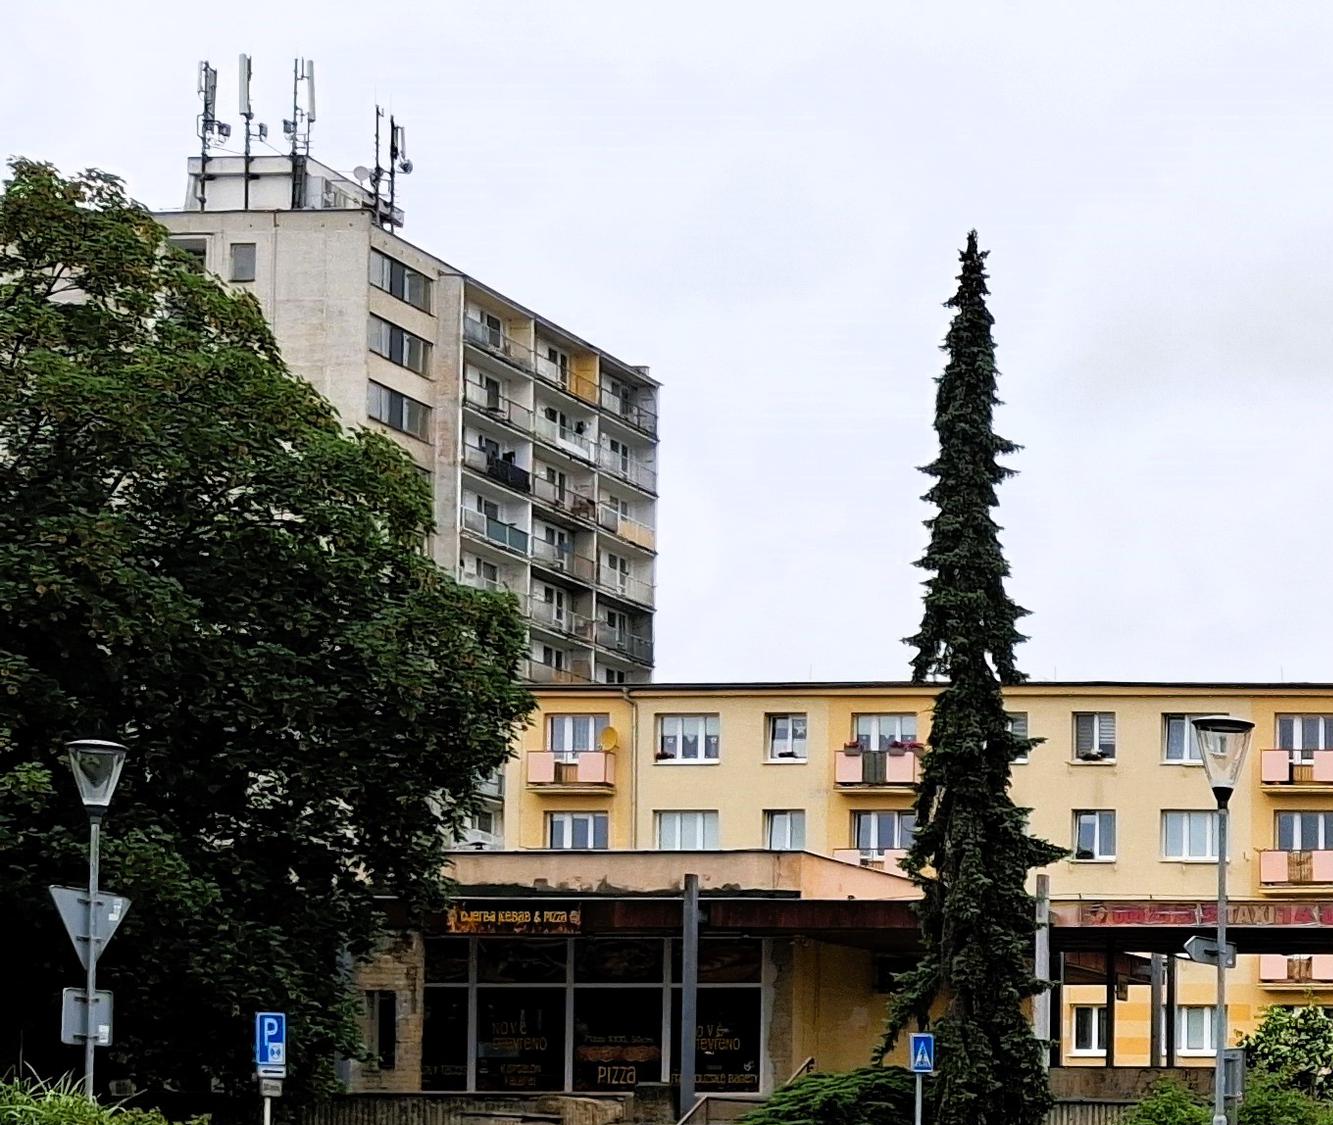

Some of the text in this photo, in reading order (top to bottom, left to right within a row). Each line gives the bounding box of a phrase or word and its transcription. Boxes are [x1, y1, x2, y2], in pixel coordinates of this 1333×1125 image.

[533, 910, 542, 923] &
[1226, 904, 1275, 925] TAXI
[264, 1017, 279, 1047] P
